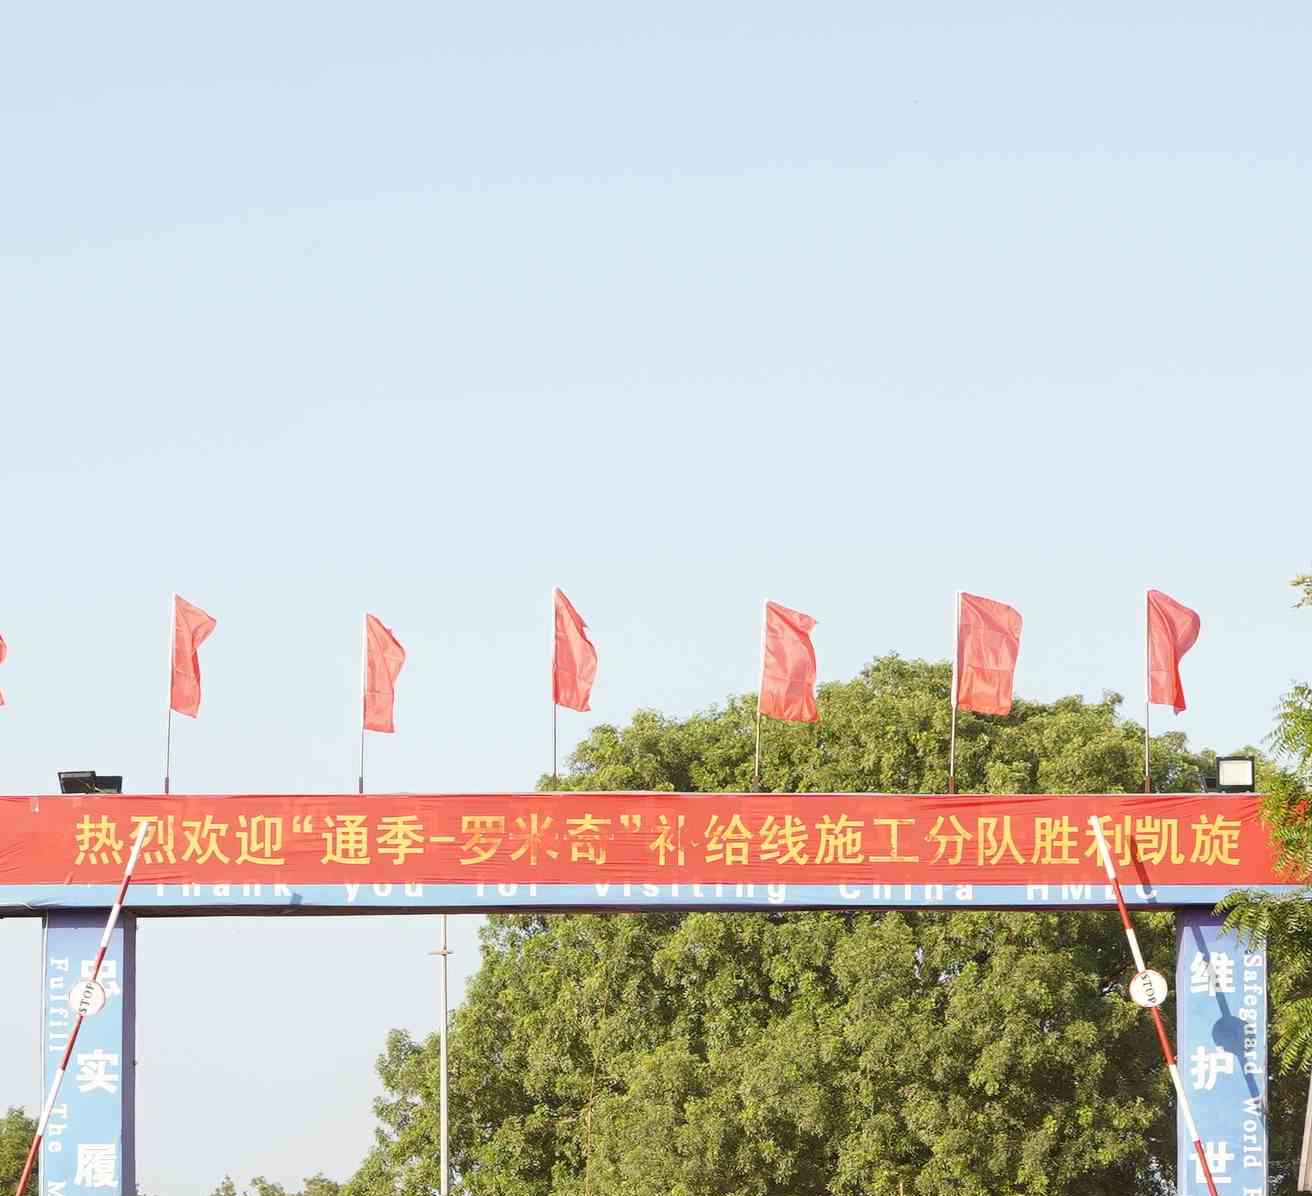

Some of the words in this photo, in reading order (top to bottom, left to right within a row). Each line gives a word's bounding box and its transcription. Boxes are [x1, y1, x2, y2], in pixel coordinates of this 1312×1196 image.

[49, 957, 69, 1052] Fulfill
[78, 983, 95, 1014] STOP
[1141, 973, 1158, 1004] STOP
[1240, 954, 1263, 1074] Safeguard
[47, 1104, 68, 1153] The
[1242, 1096, 1263, 1168] World
